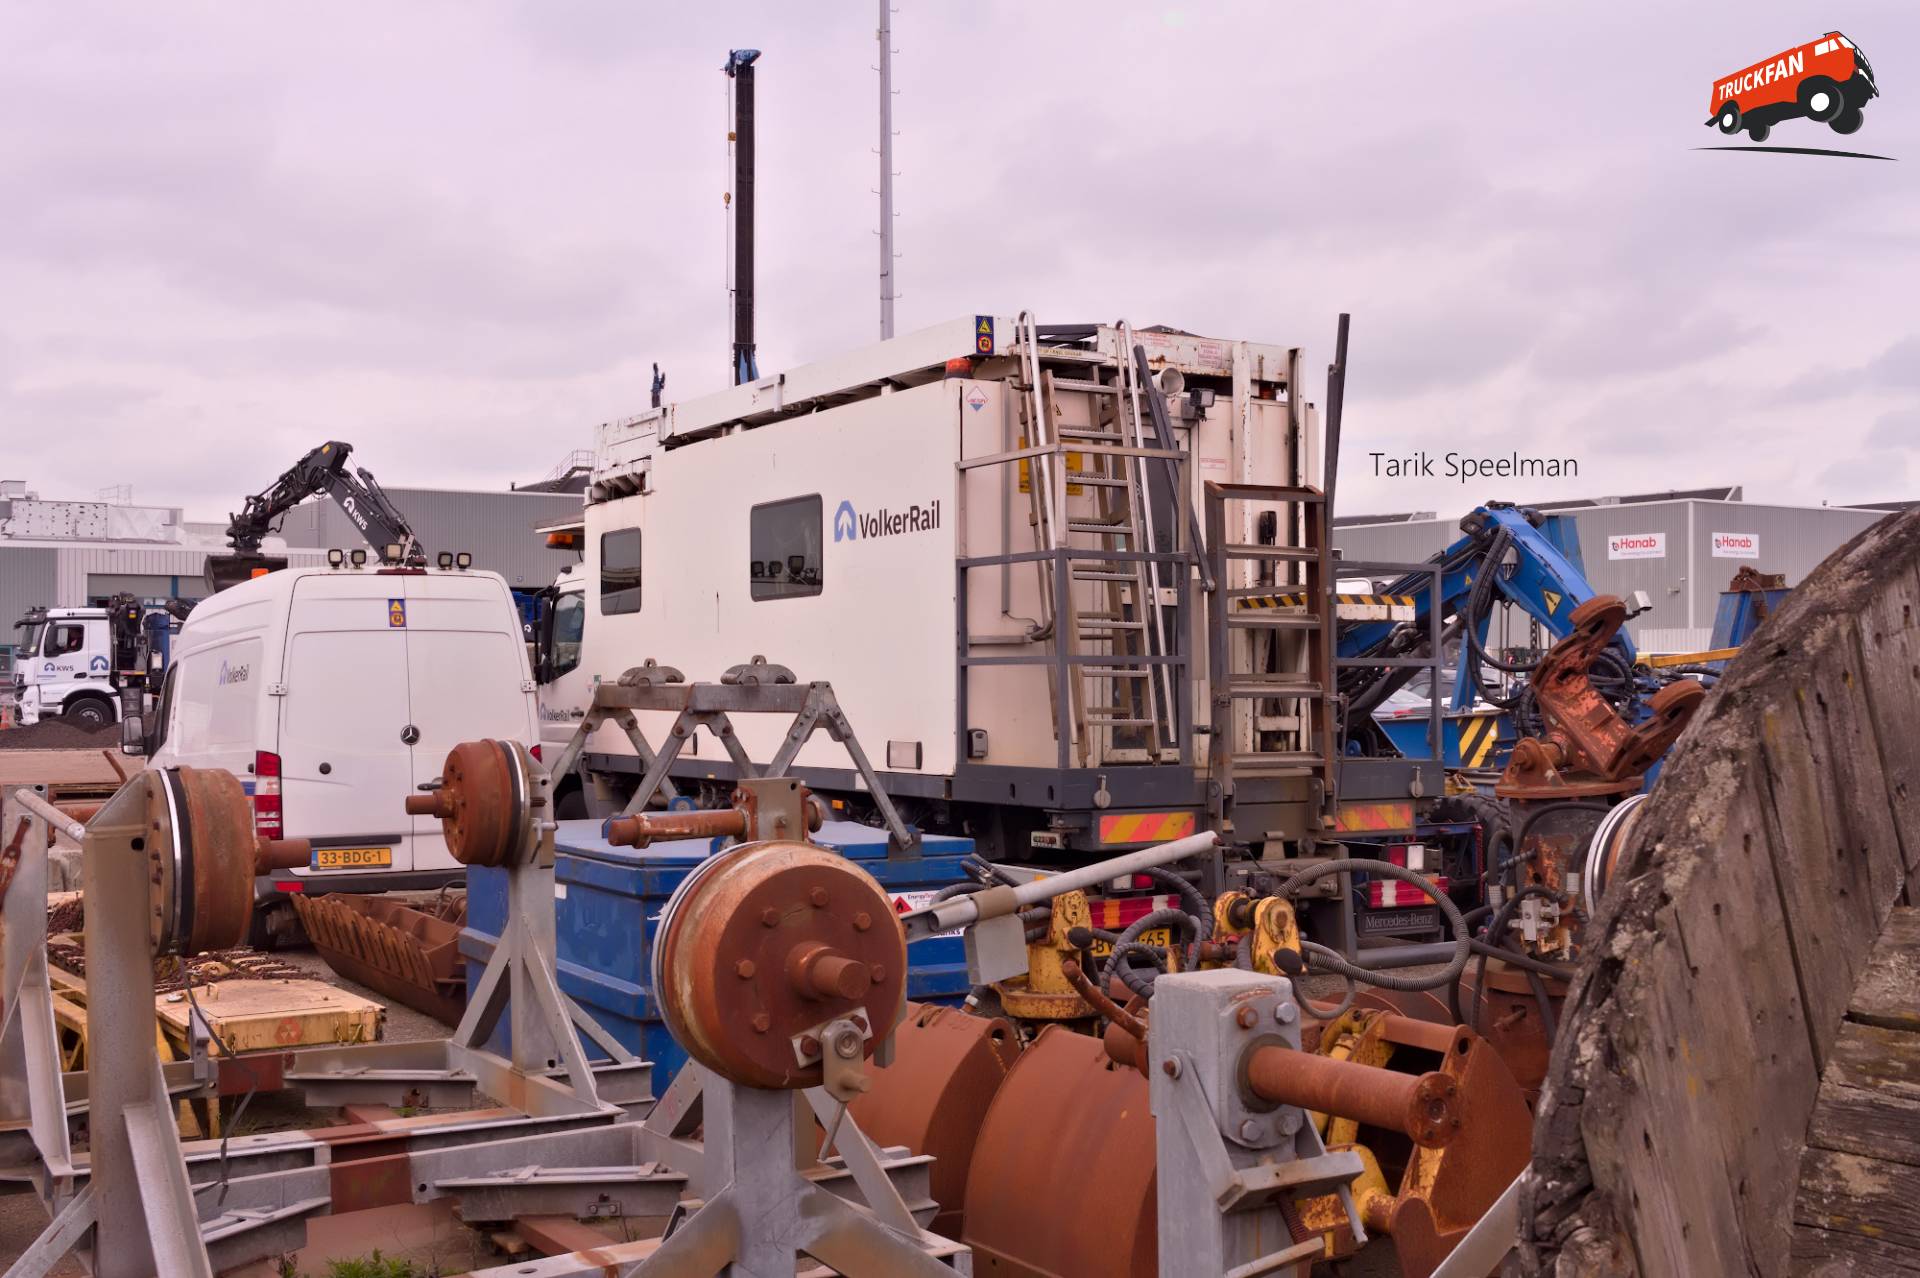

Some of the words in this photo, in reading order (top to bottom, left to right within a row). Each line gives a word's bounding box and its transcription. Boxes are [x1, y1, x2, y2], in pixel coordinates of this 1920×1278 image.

[352, 509, 368, 530] KWS
[859, 500, 940, 539] VolkerRail
[1620, 537, 1657, 549] Hanab
[1722, 536, 1752, 548] Hanab
[321, 851, 381, 864] 33-BDG-1
[1365, 913, 1433, 929] Mercedes-Benz
